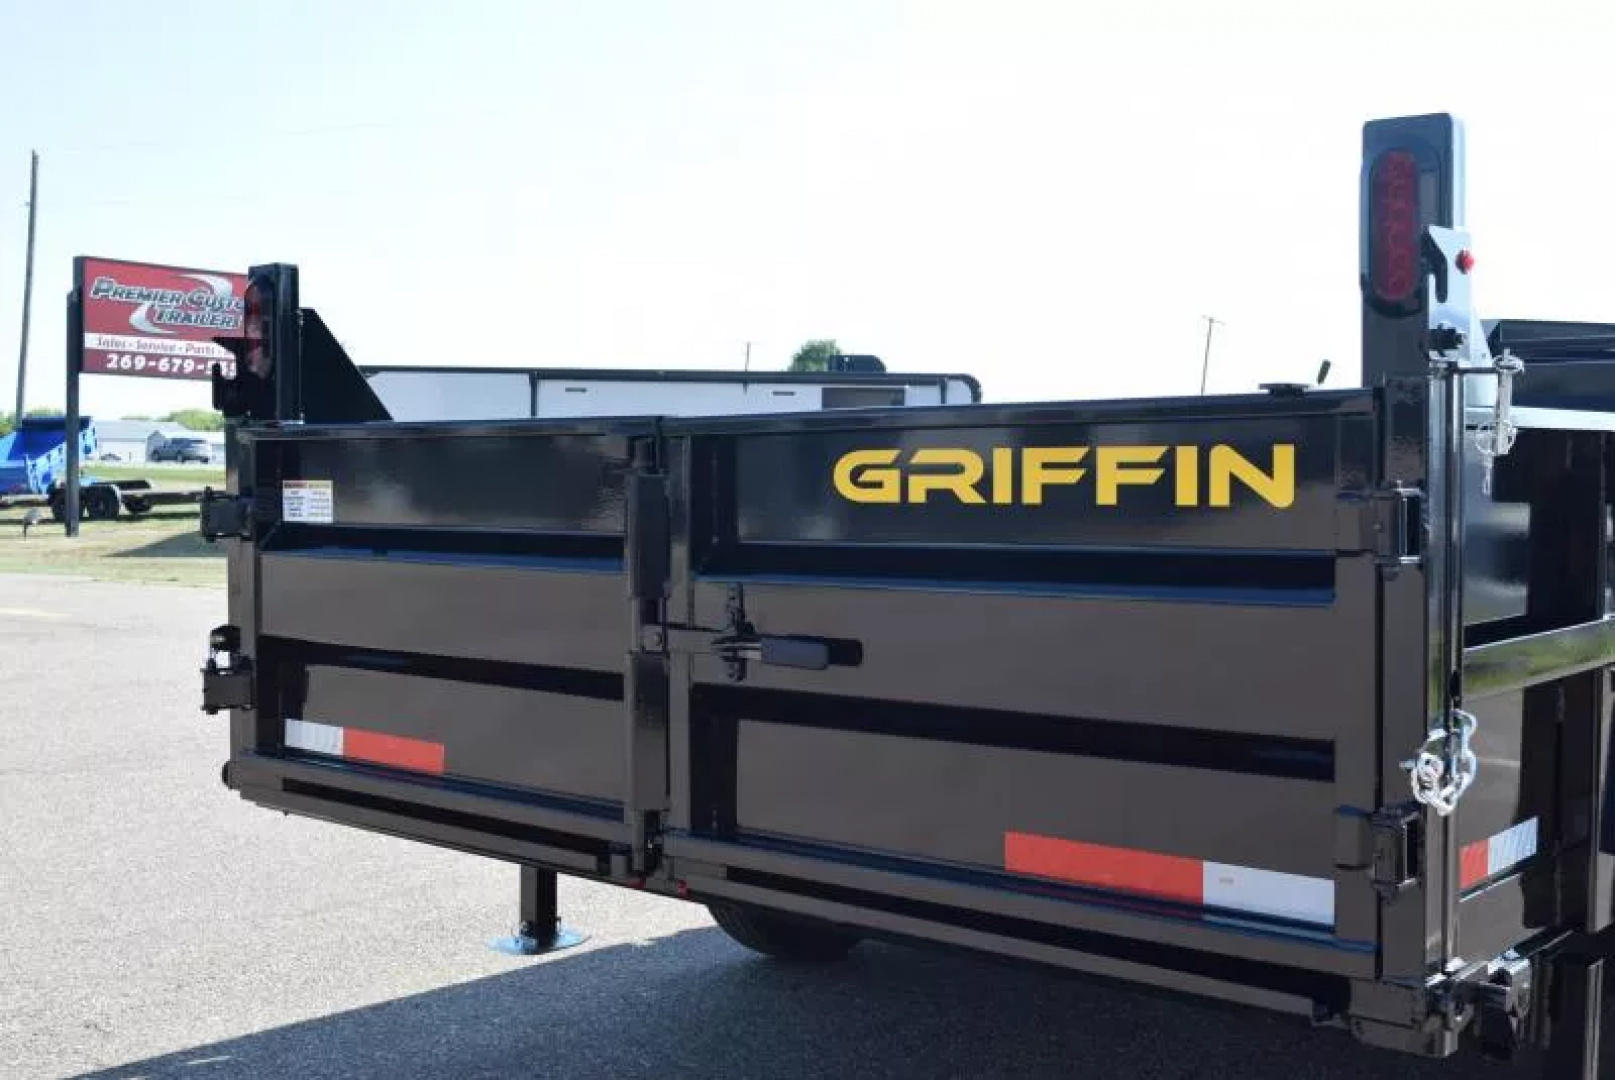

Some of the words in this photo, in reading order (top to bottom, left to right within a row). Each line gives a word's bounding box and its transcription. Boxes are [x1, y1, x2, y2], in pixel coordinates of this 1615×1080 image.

[90, 276, 184, 306] PREMIER
[186, 286, 245, 311] CUSTO
[833, 443, 1295, 508] GRIFFIN
